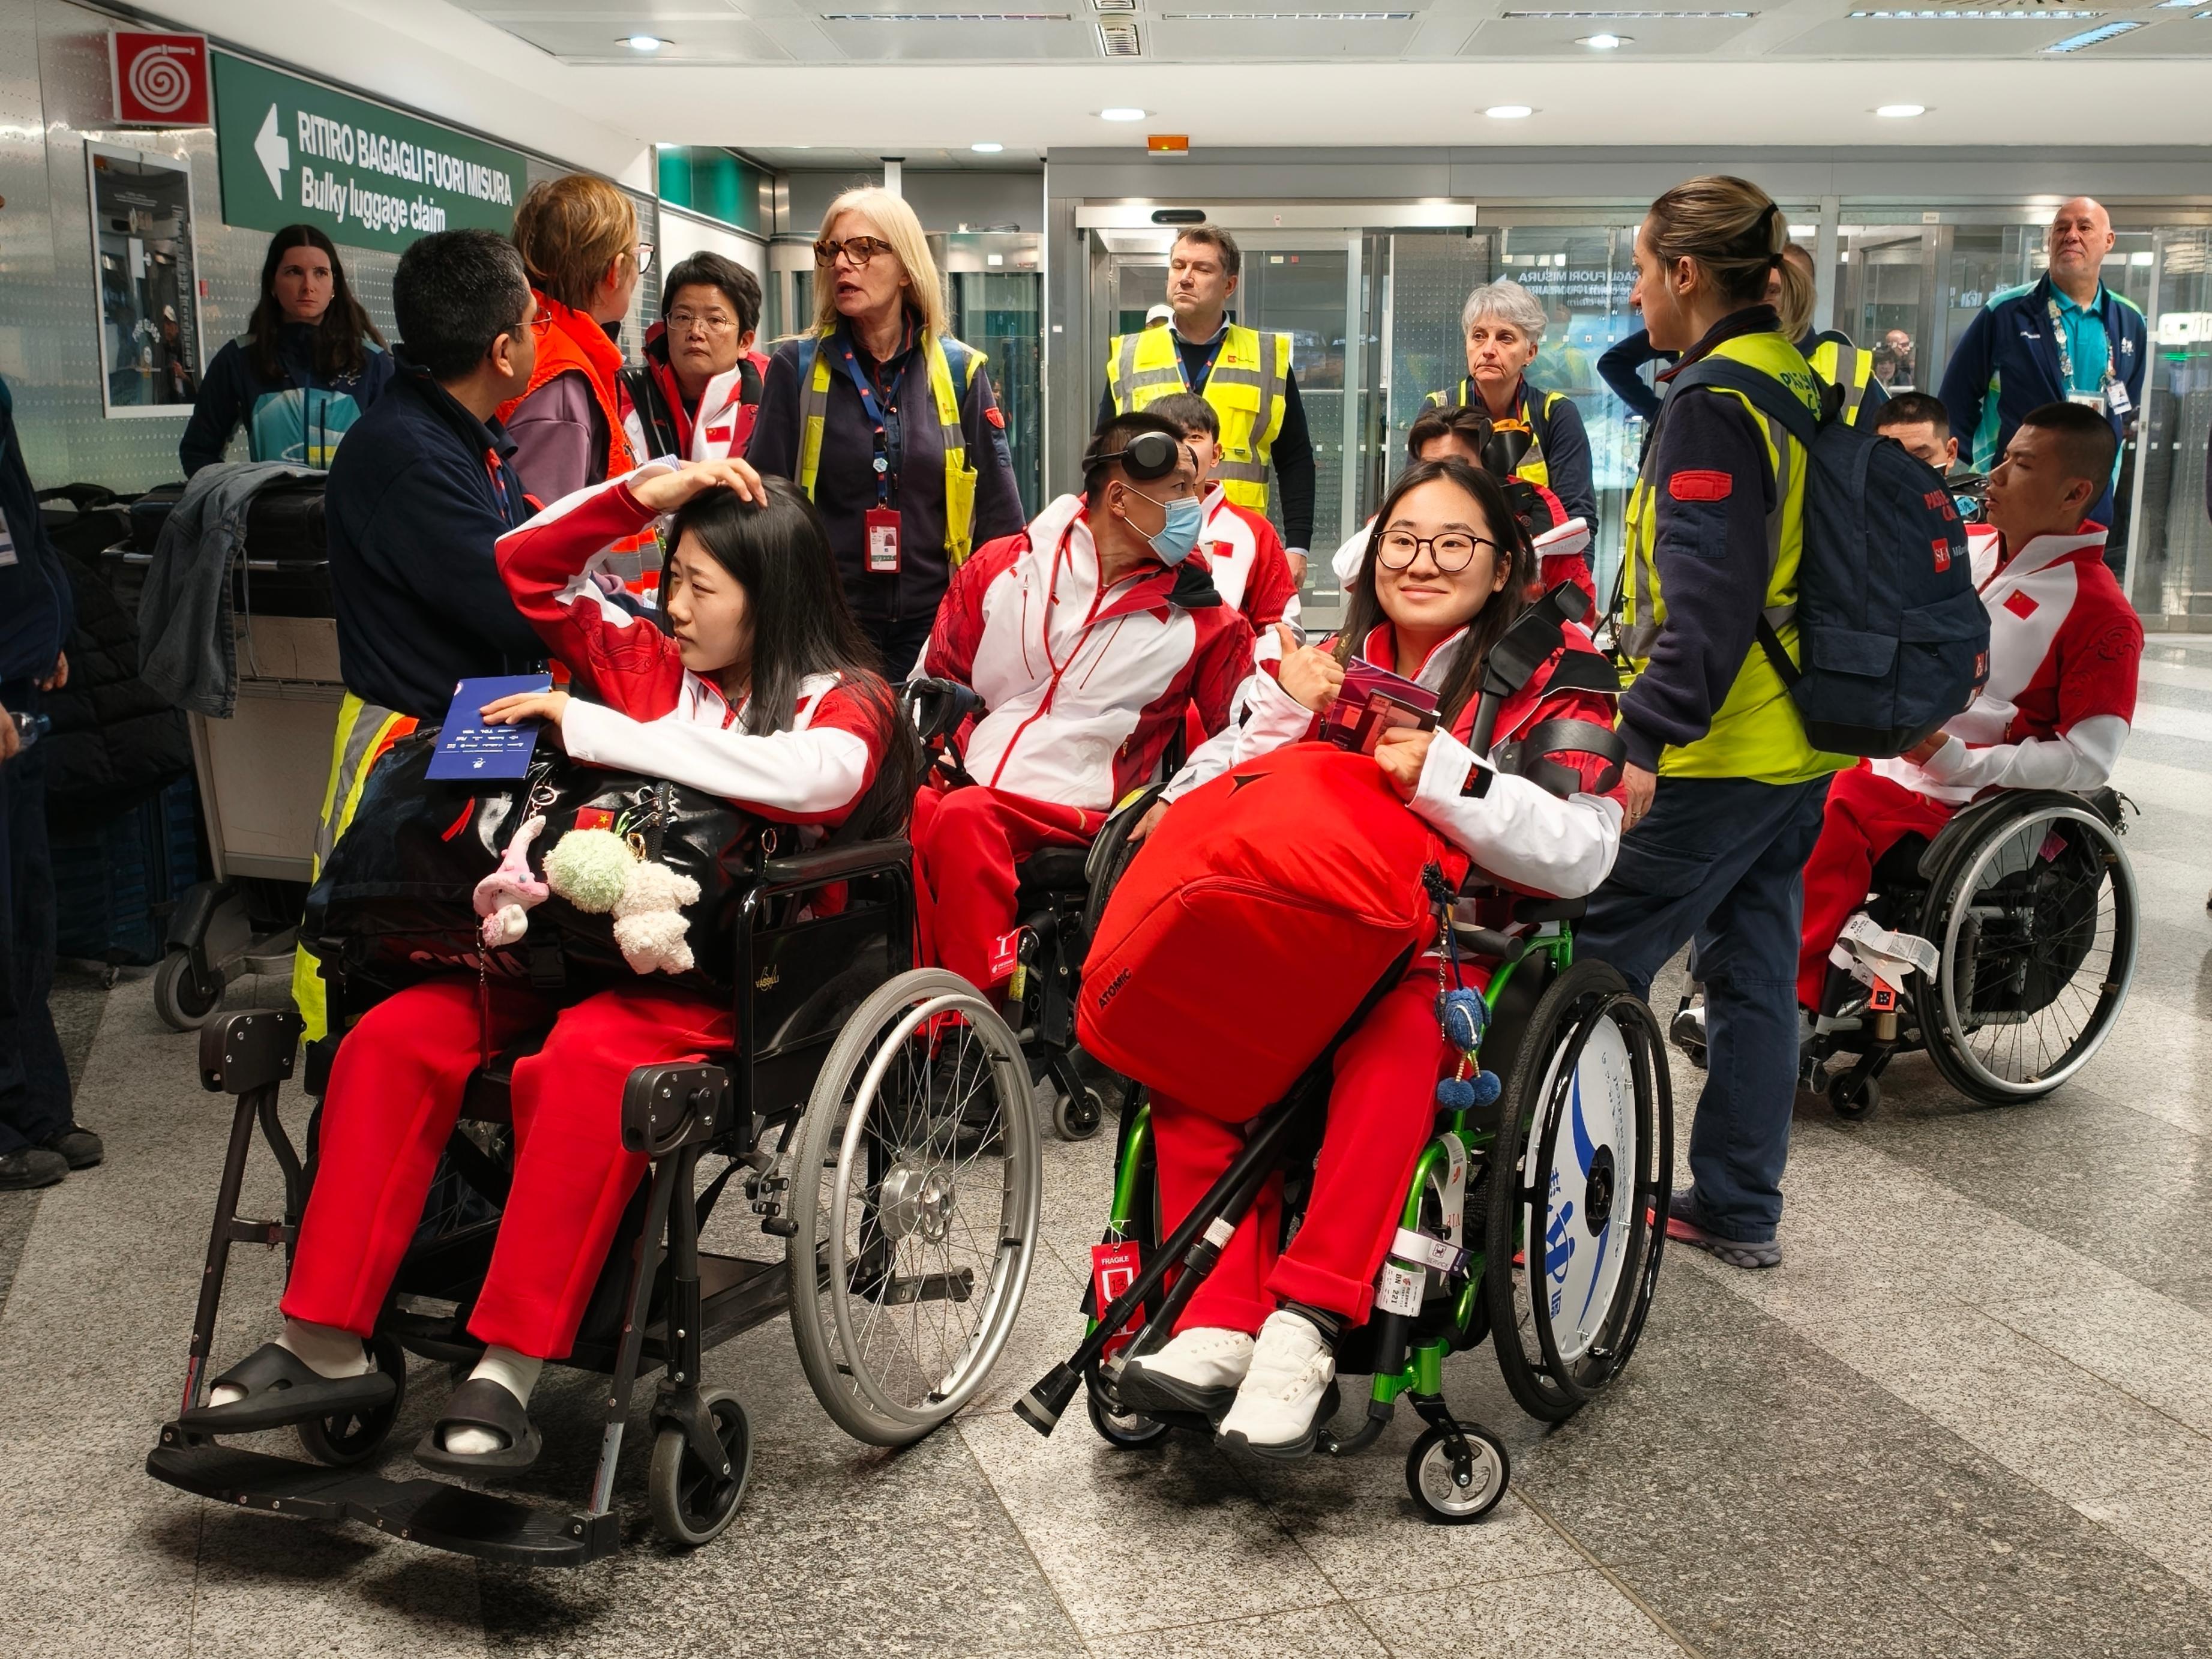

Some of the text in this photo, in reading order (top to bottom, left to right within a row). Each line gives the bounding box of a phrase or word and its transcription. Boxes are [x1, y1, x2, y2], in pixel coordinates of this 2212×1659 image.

[298, 110, 513, 206] RITIRO BAGAGLI FUORI MISURA
[302, 166, 445, 234] Bulky luggage claim
[1098, 968, 1132, 1011] ATOMIC
[1446, 1212, 1461, 1227] VIP
[1101, 1255, 1129, 1265] FRAGILE
[1426, 1257, 1450, 1269] SERVICE
[1111, 1278, 1127, 1292] 13
[1391, 1290, 1399, 1304] 221
